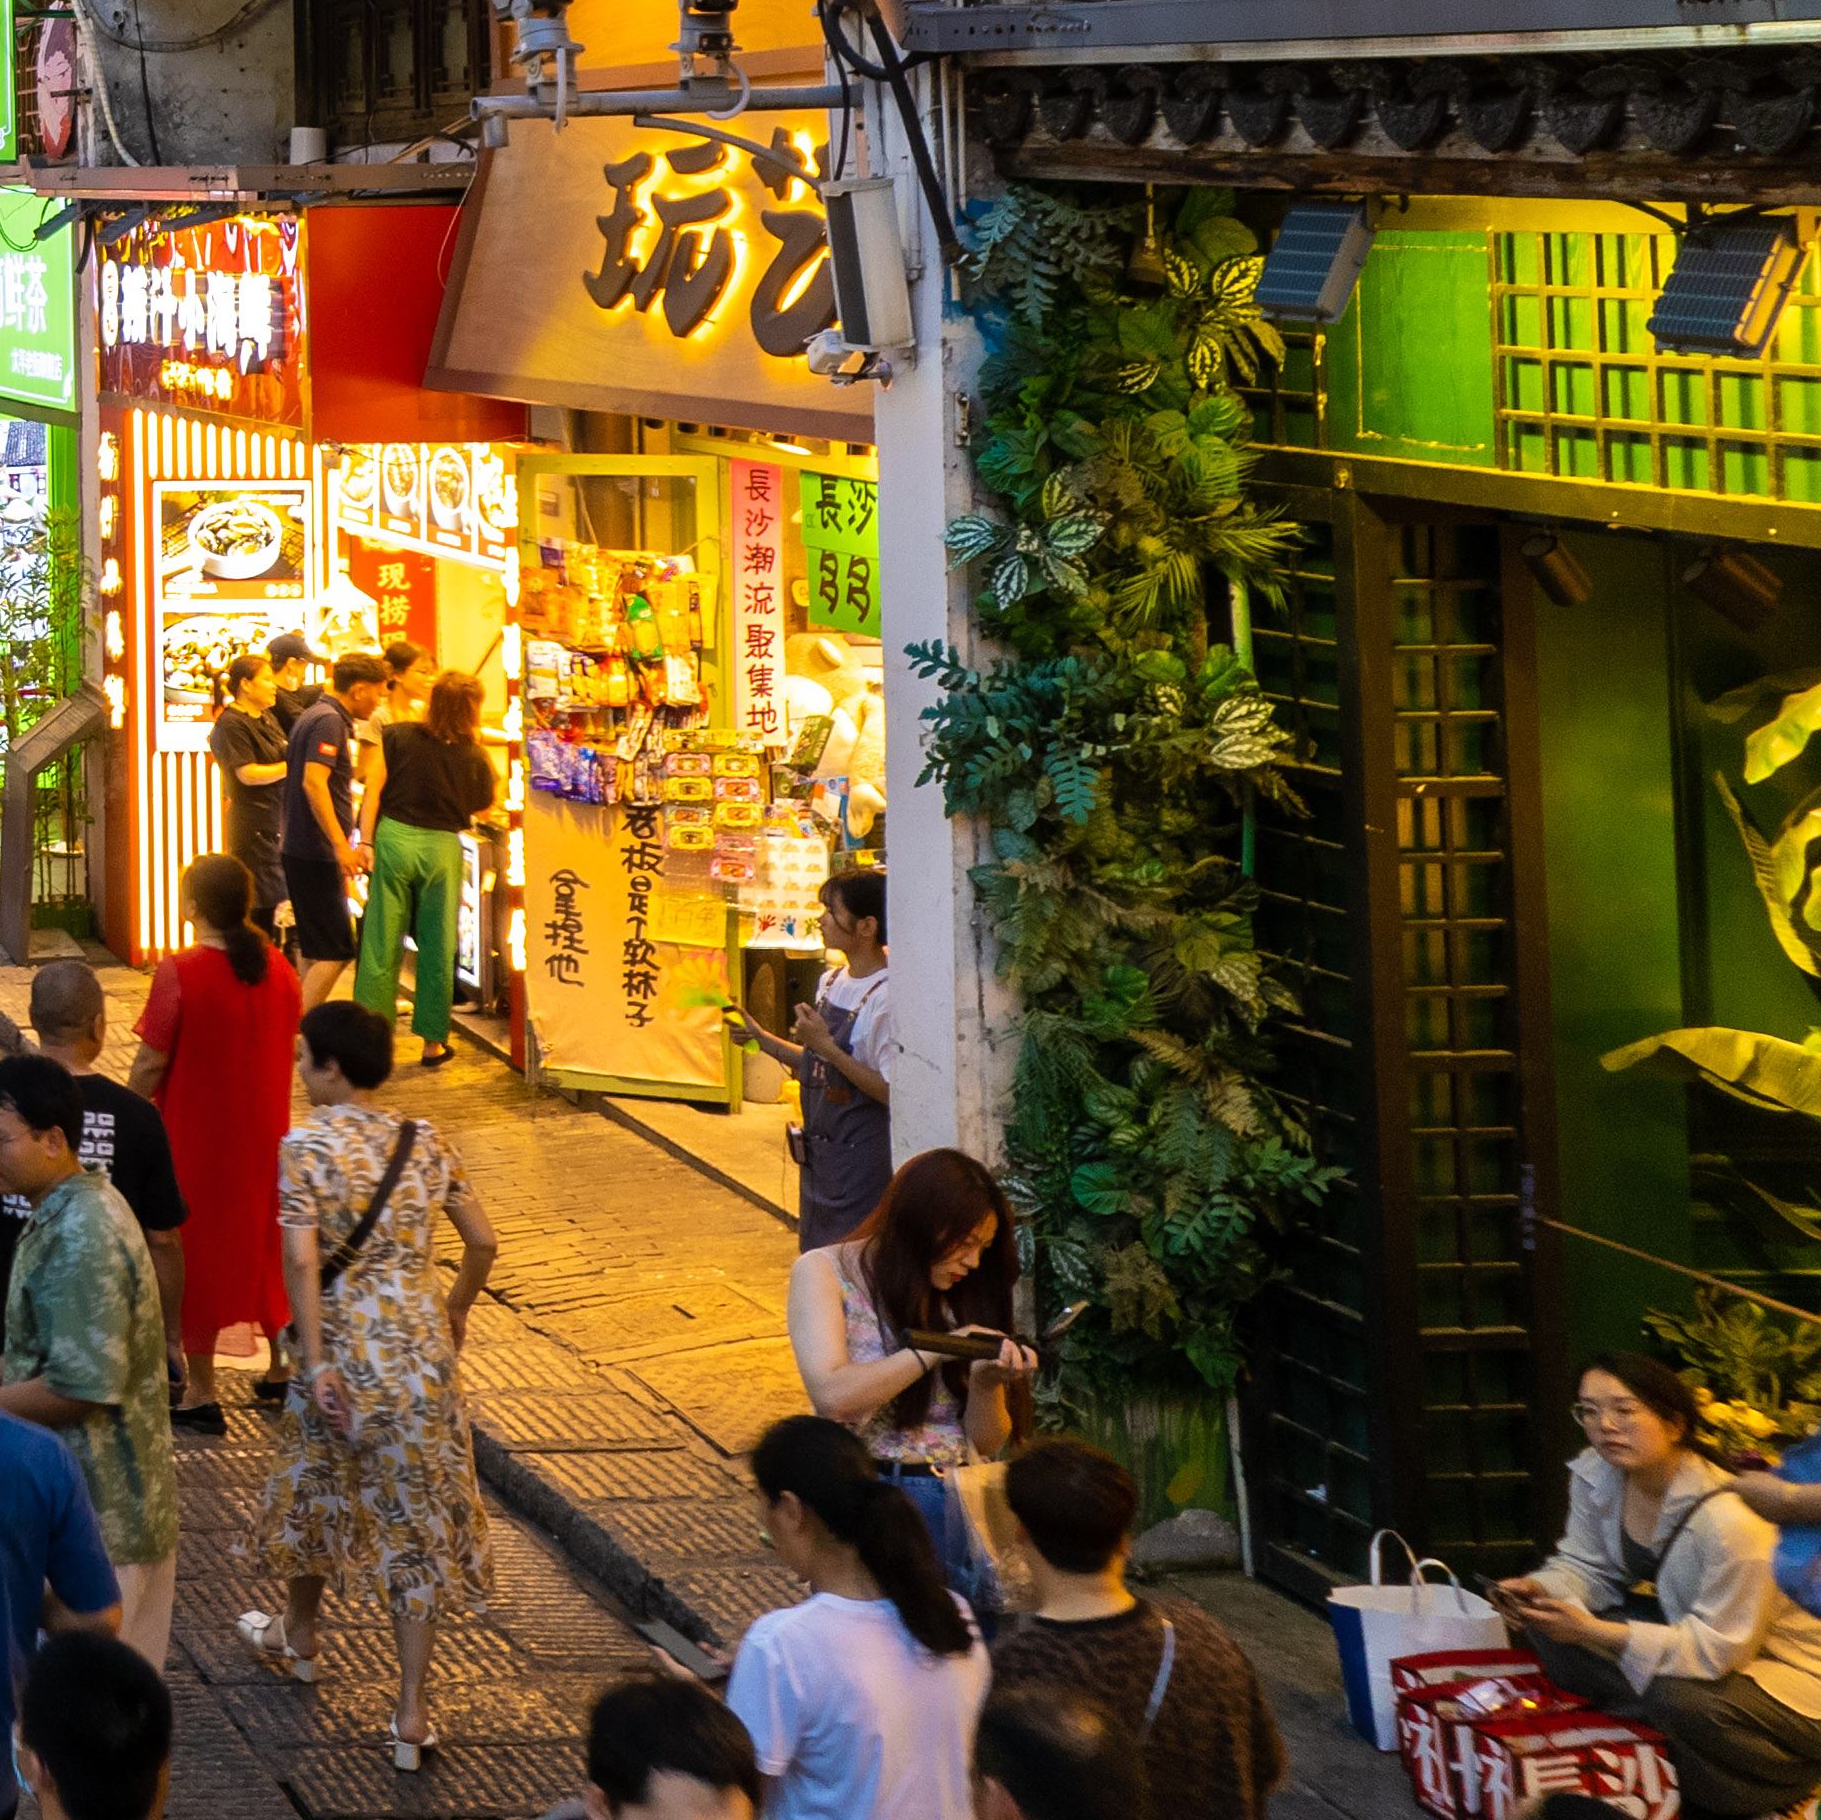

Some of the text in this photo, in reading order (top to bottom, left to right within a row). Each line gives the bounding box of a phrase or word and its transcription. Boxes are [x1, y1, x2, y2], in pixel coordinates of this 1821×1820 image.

[742, 468, 779, 735] 長沙潮流聚集地
